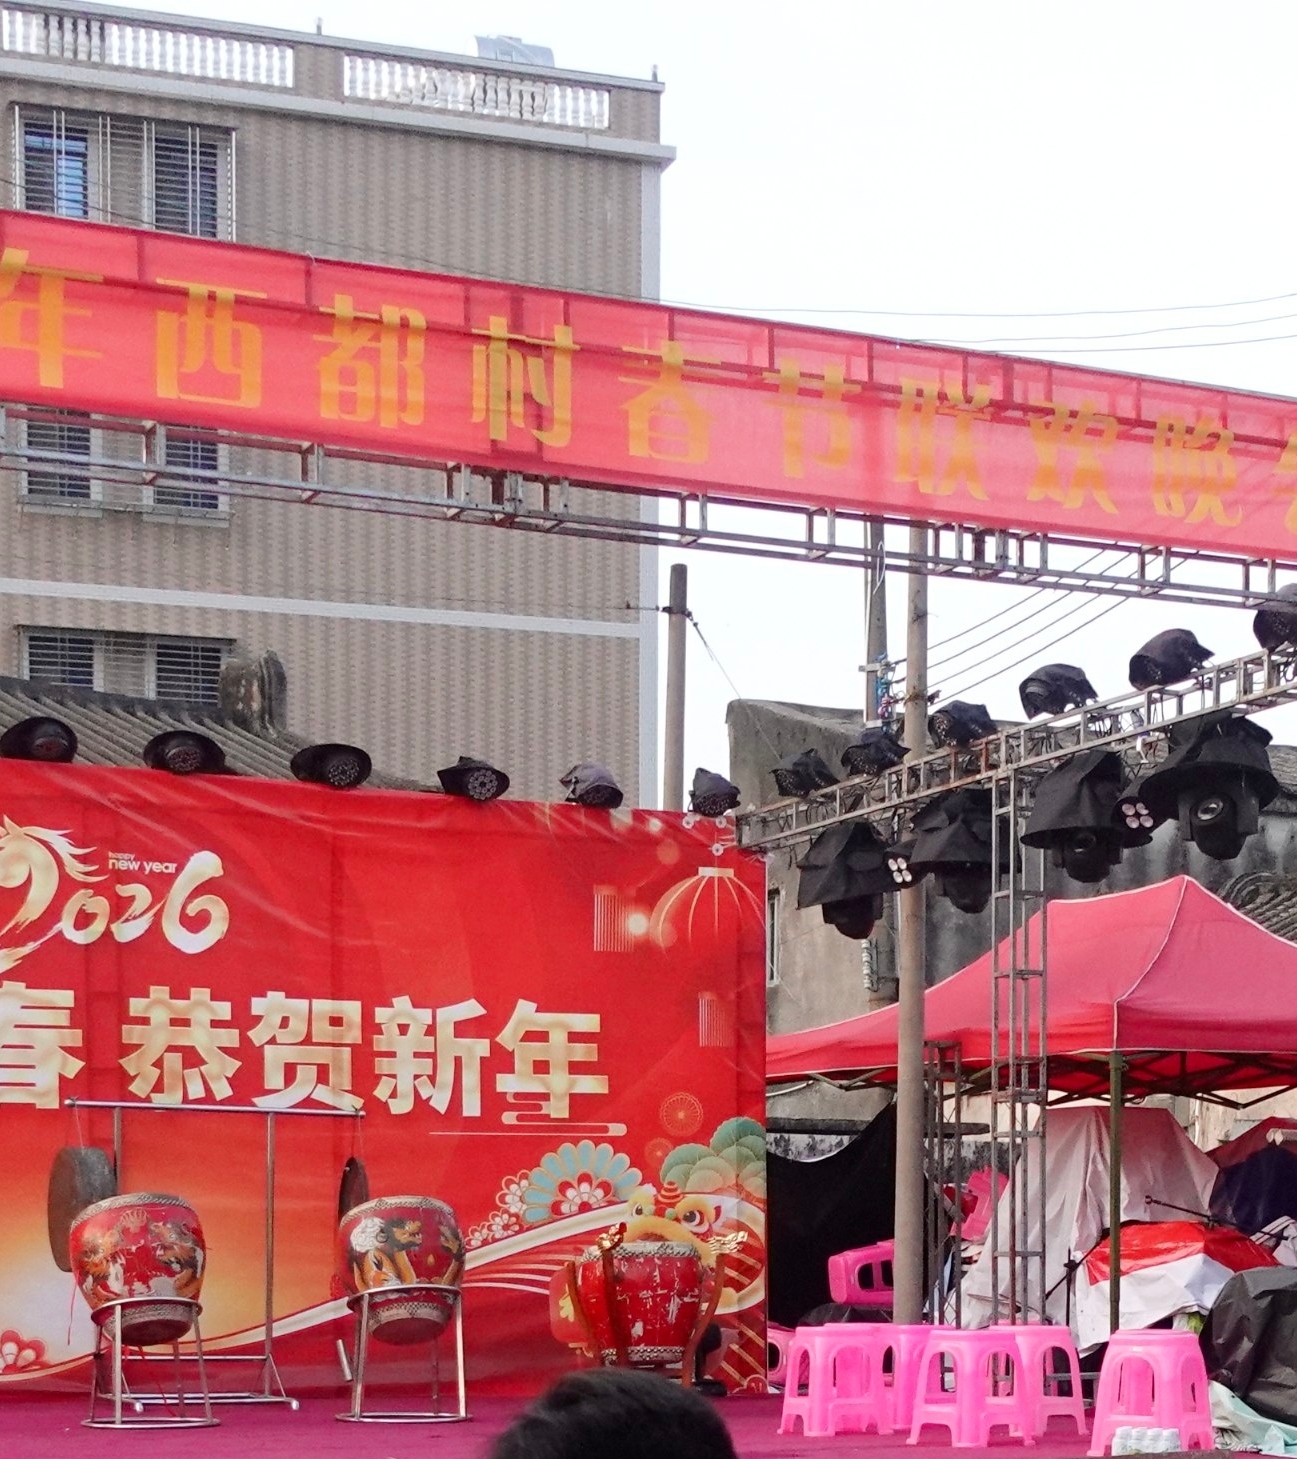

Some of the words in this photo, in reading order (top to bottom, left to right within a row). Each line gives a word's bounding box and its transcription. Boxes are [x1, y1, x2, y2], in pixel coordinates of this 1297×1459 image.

[108, 859, 140, 871] new
[143, 861, 178, 875] year
[120, 985, 611, 1120] 恭贺新年
